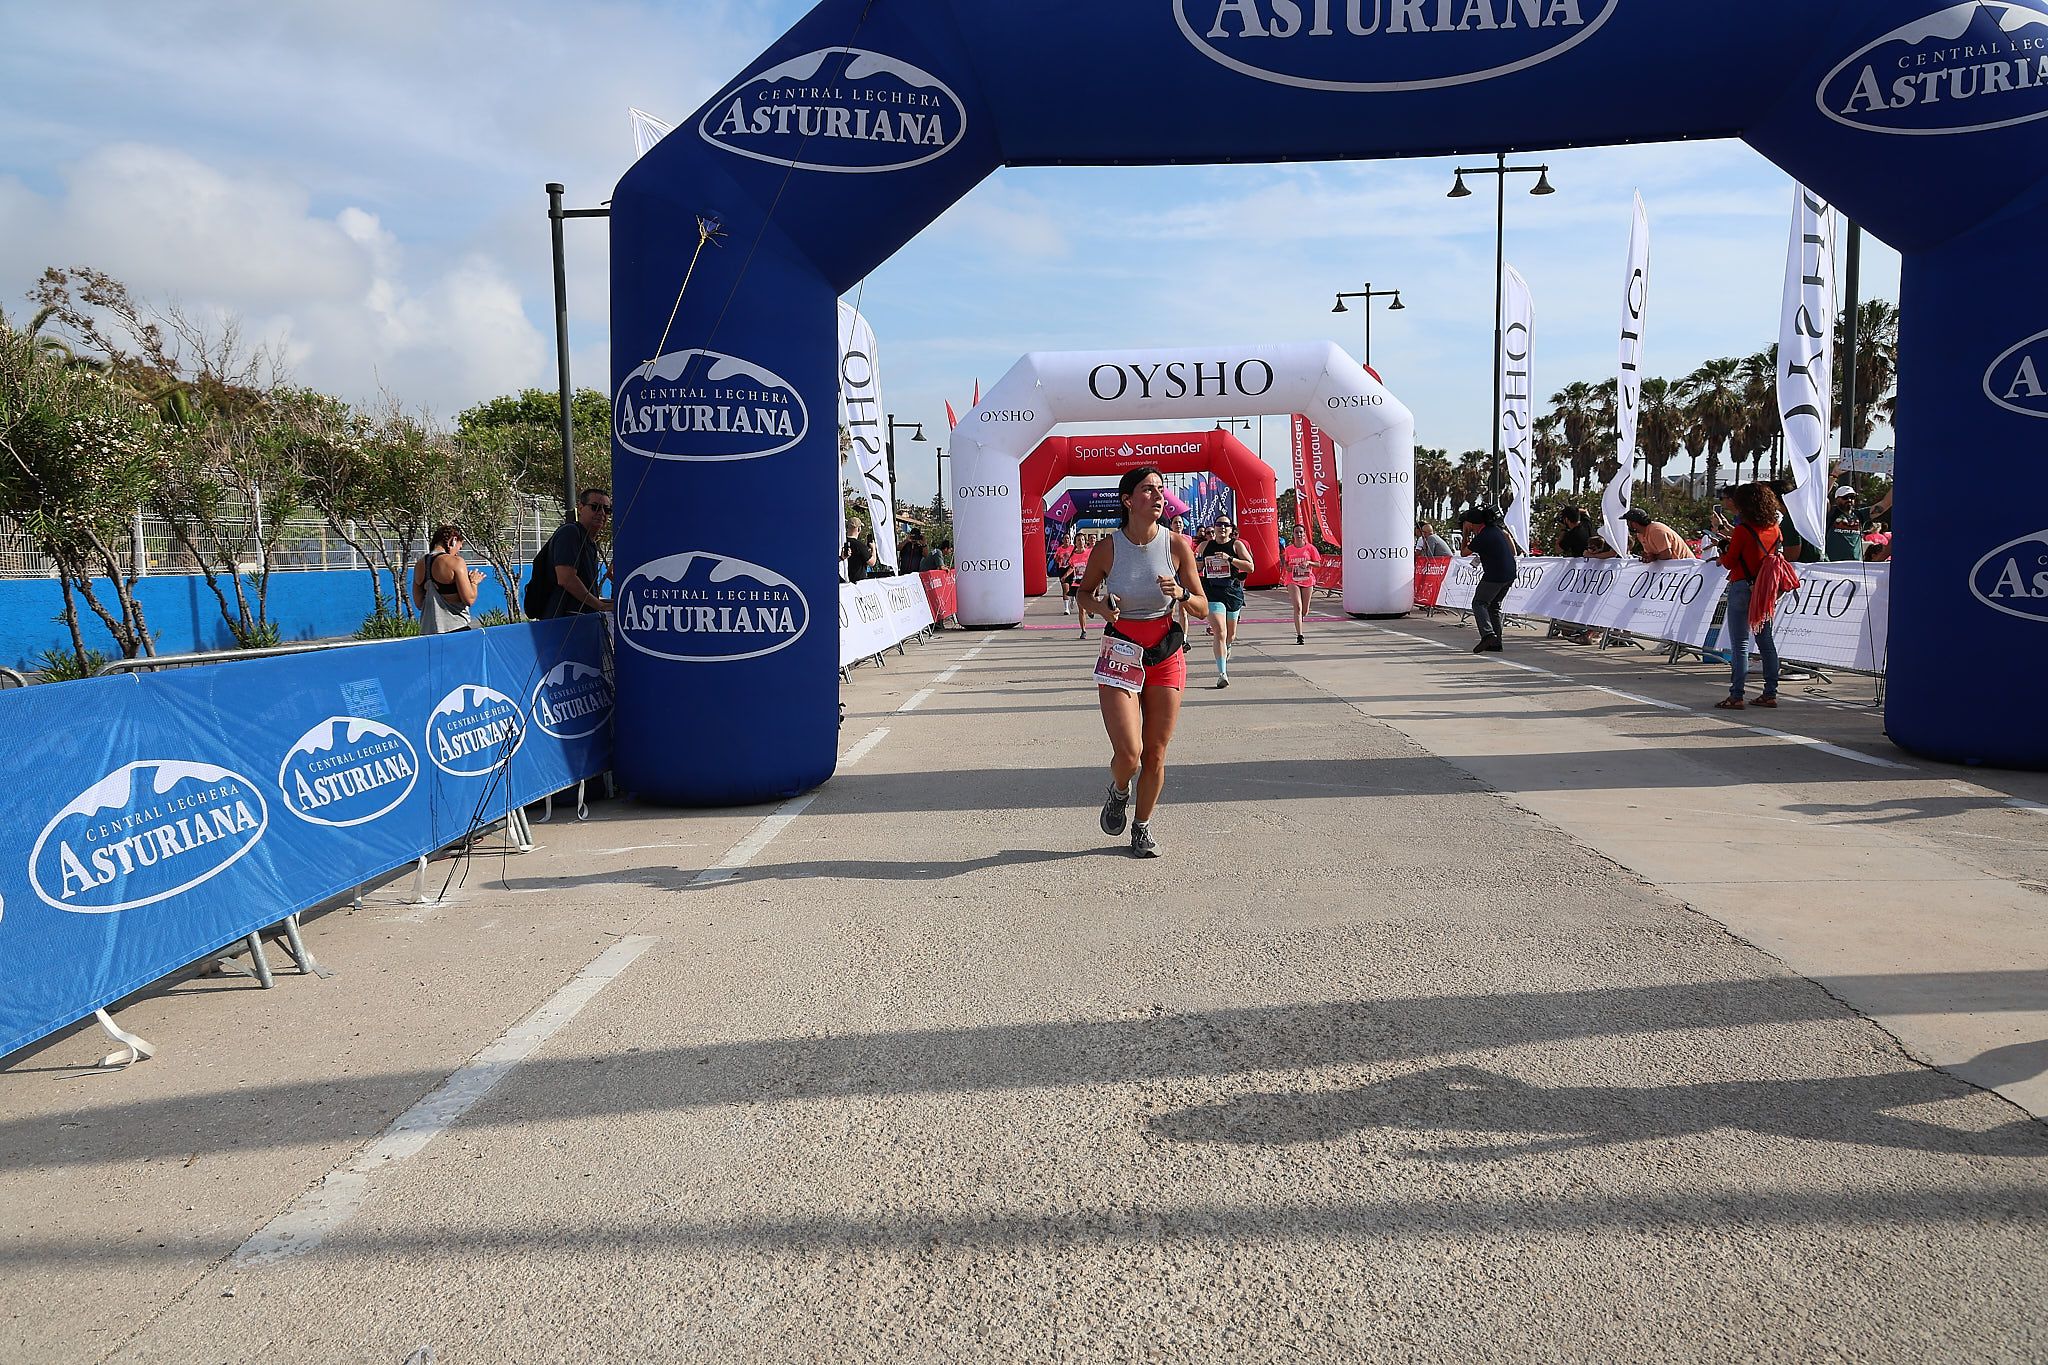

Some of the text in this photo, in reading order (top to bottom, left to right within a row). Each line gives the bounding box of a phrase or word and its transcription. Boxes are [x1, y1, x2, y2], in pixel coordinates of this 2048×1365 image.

[1898, 44, 2000, 69] CENTRAL
[759, 87, 940, 107] CENTRAL LECHERA
[1841, 55, 2048, 114] ASTURIA
[713, 97, 945, 146] ASTURIANA
[1088, 359, 1274, 401] OYSHO
[641, 388, 788, 404] CENTRAL LECHERA
[1327, 394, 1383, 409] OYSHO
[620, 394, 796, 437] ASTURIANA
[980, 409, 1034, 422] OYSHO
[1075, 441, 1202, 461] Sports Santander
[959, 484, 1009, 498] OYSHO
[1357, 471, 1409, 485] OYSHO
[961, 558, 1010, 572] OYSHO
[1357, 546, 1409, 560] OYSHO
[643, 588, 789, 601] CENTRAL LECHERA
[1557, 568, 1614, 596] OYSHO
[1628, 570, 1704, 605] OYSHO
[623, 590, 796, 633] ASTURIANA
[1108, 660, 1129, 673] 016
[437, 715, 520, 764] ASTURIANA
[309, 740, 400, 773] CENTRAL LECHERA
[295, 753, 413, 811] ASTURIANA
[86, 783, 240, 842] CENTRAL LECHERA
[61, 800, 258, 899] ASTURIANA
